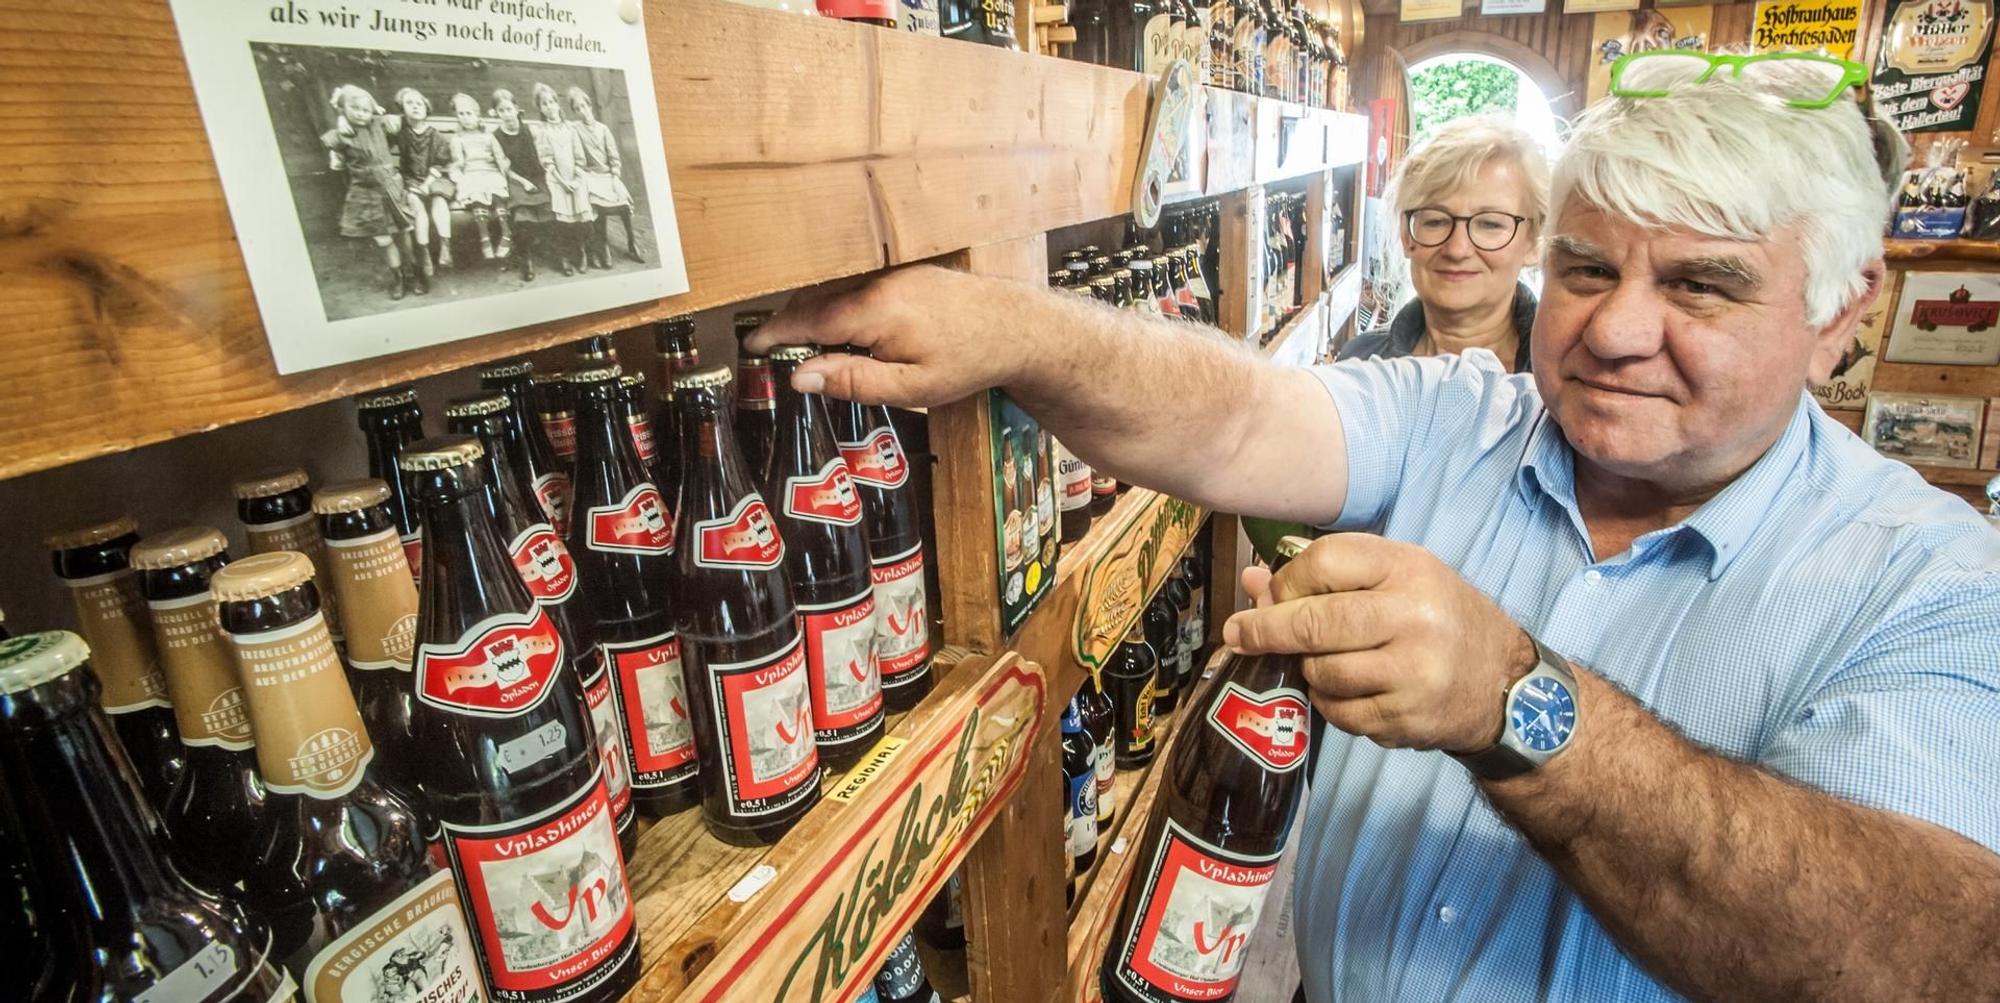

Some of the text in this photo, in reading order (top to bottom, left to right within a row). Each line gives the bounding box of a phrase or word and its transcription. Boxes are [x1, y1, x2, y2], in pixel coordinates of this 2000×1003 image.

[490, 0, 577, 25] einfacher,
[270, 3, 607, 54] als wir Jungs noch doof fanden.
[1900, 97, 1928, 112] dem
[1900, 105, 1963, 129] Hallertau!
[168, 638, 188, 648] AUS
[240, 644, 296, 661] ERZQUELL
[255, 677, 278, 687] AUS
[282, 671, 306, 683] DER
[500, 680, 540, 704] Opladen
[538, 725, 562, 748] 1.25
[773, 706, 982, 1003] Kölsch
[329, 918, 401, 979] BERGISCHE
